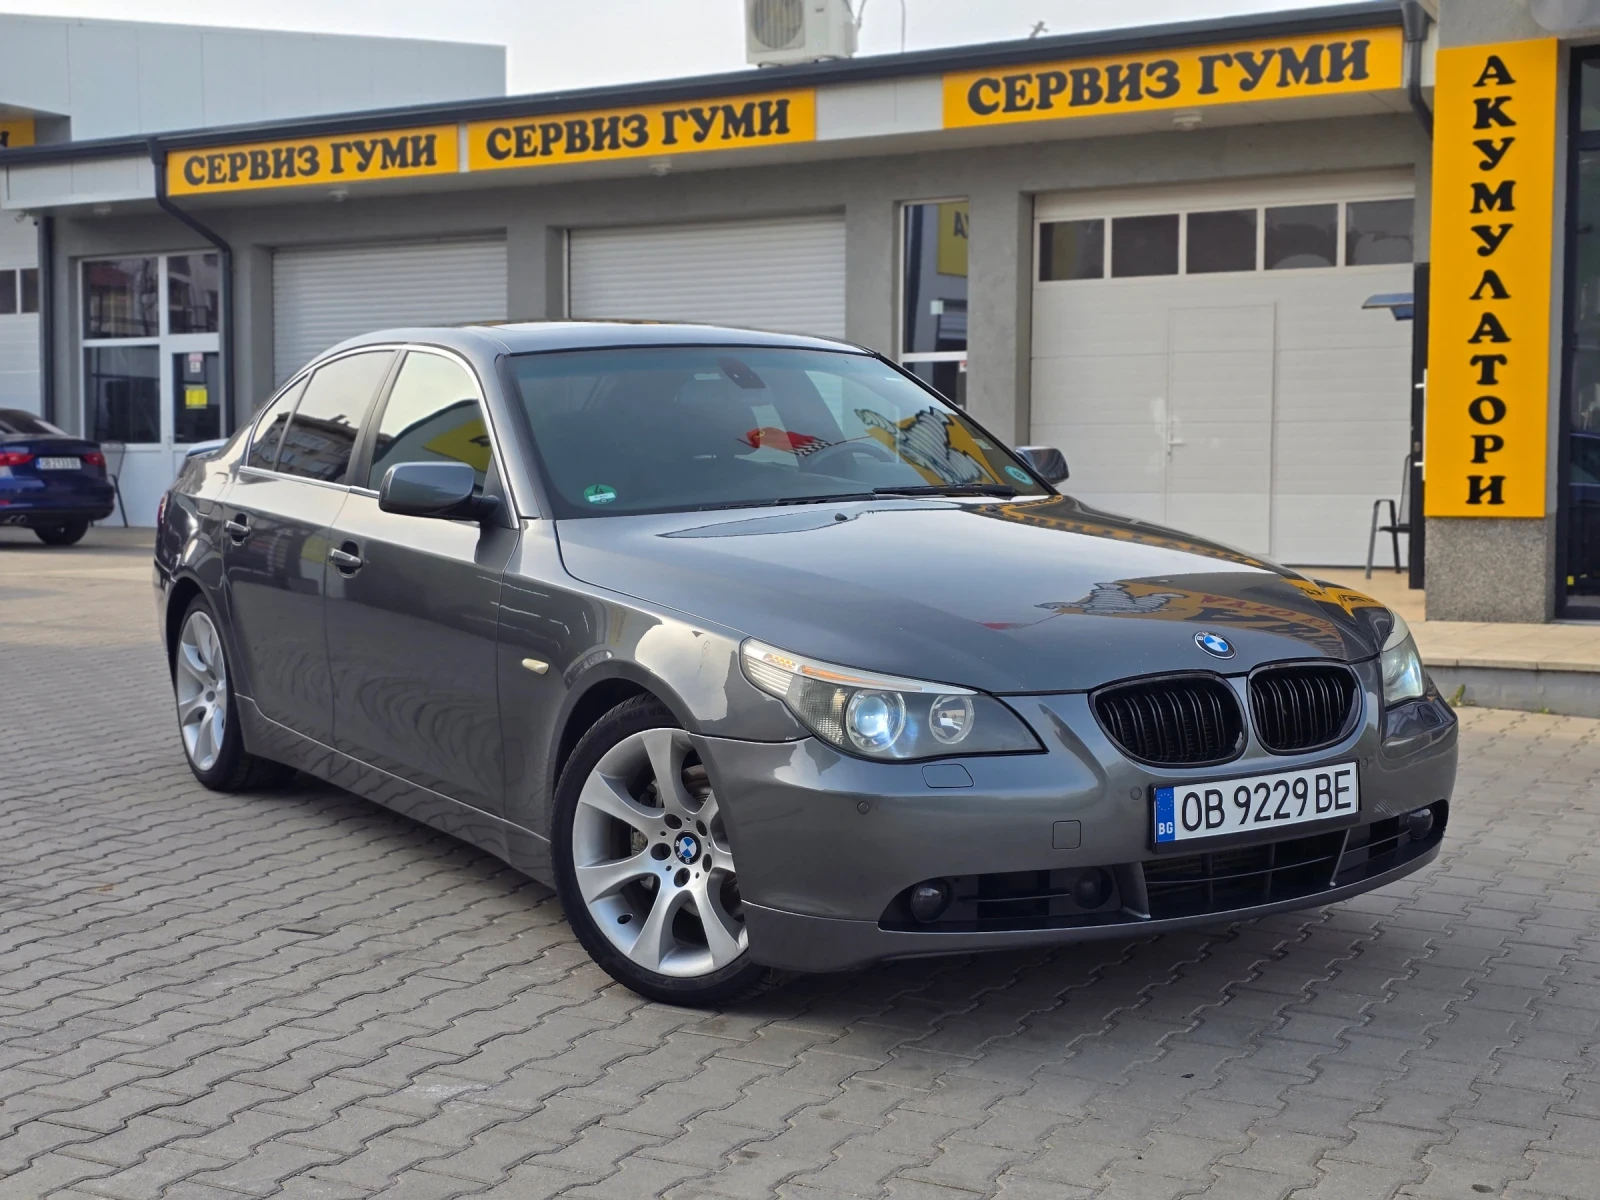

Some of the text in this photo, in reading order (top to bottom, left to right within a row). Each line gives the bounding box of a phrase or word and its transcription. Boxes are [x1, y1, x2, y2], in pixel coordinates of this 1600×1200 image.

[967, 39, 1371, 116] СЕРВИЗ ГУМИ
[184, 134, 437, 186] СЕРВИЗ ГУМИ
[486, 99, 791, 160] СЕРВИЗ ГУМИ
[1465, 54, 1517, 506] АКУМУЛАТОРИ
[1158, 821, 1174, 835] BG
[1181, 769, 1352, 832] OB 9229 BE
